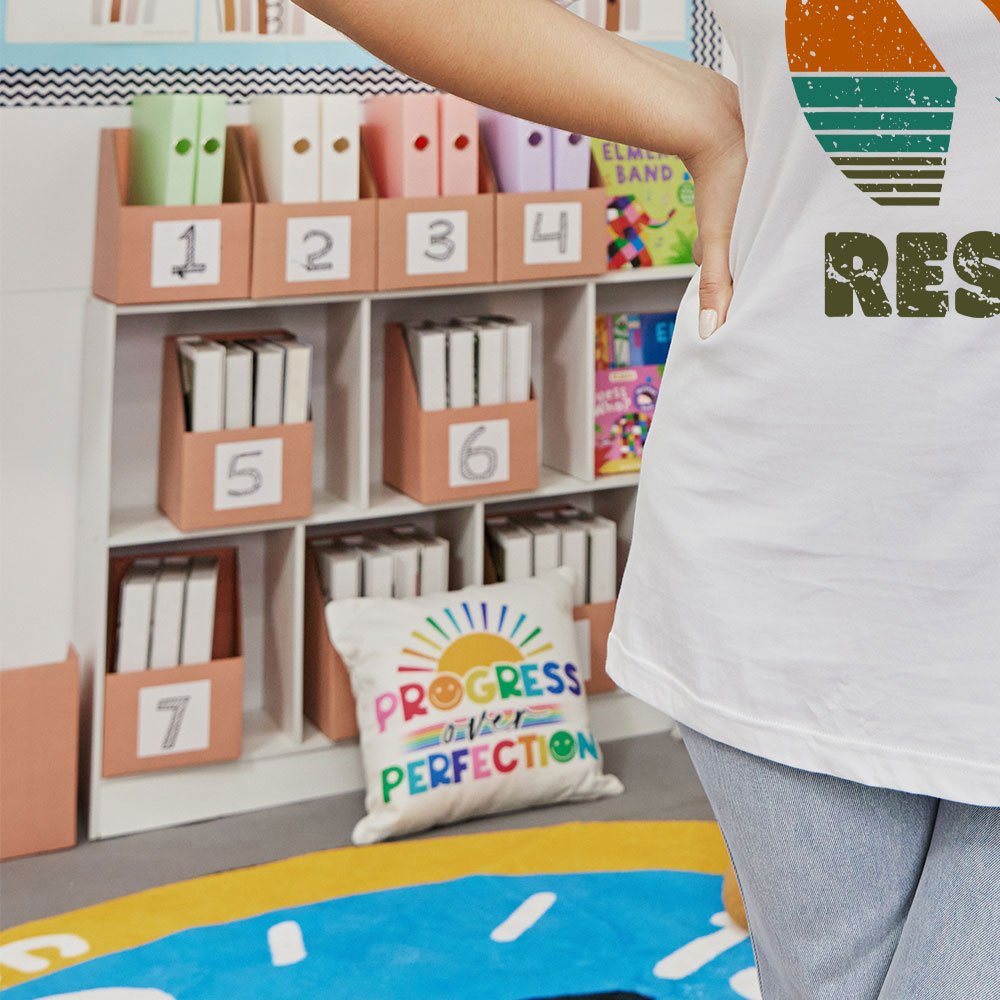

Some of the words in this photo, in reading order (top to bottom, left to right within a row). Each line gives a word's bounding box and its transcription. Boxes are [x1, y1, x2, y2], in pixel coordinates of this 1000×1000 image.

[615, 164, 674, 184] BAND
[171, 223, 207, 280] 1
[299, 229, 335, 272] 2
[423, 219, 456, 262] 3
[530, 210, 570, 254] 4
[226, 450, 264, 497] 5
[459, 426, 499, 481] 6
[374, 661, 582, 734] PROGRESS
[156, 694, 191, 750] 7
[443, 708, 530, 743] over
[381, 729, 599, 804] PERFECTION
